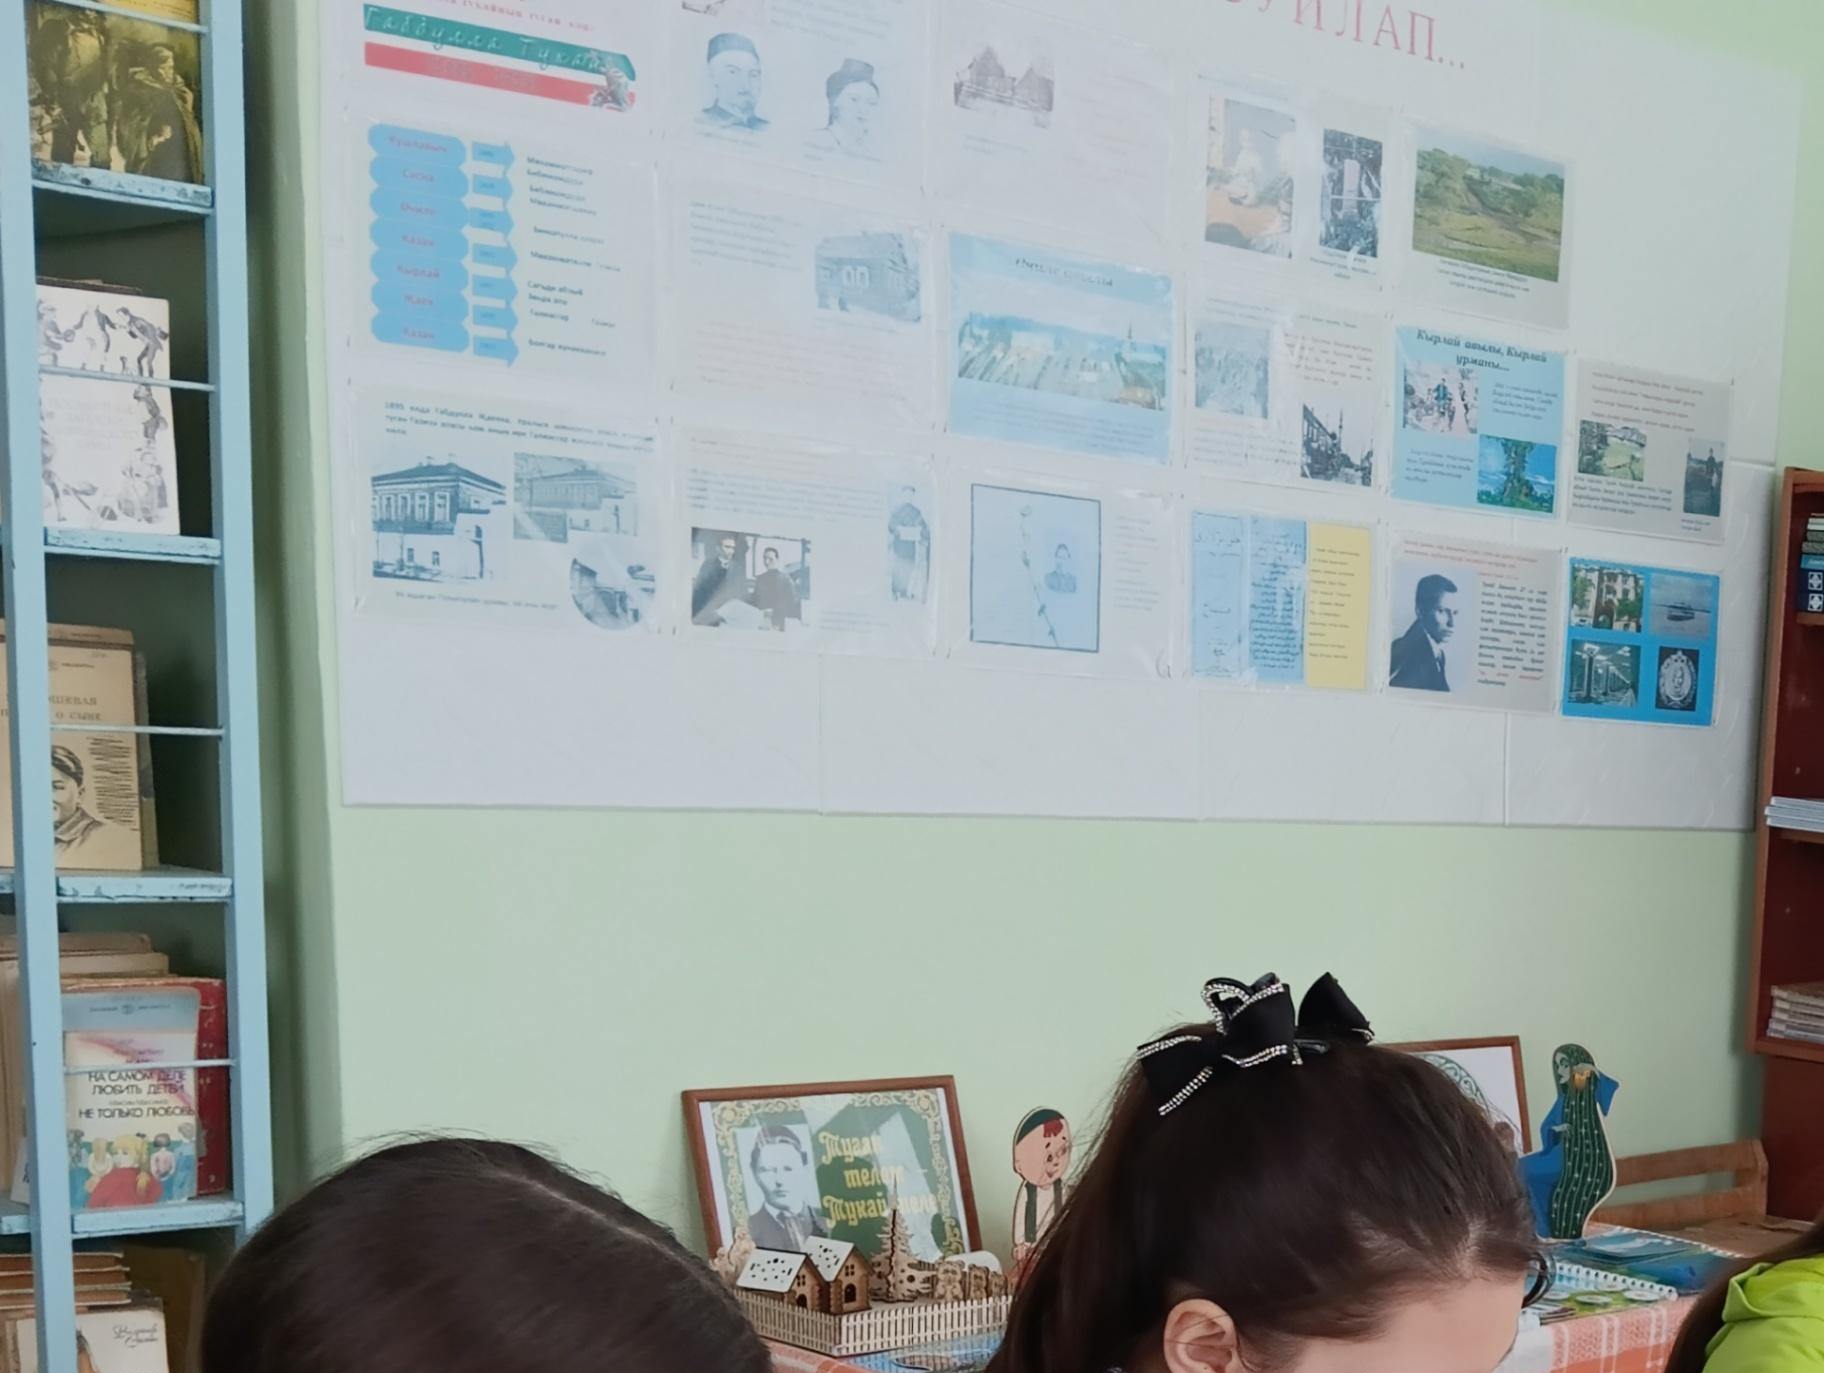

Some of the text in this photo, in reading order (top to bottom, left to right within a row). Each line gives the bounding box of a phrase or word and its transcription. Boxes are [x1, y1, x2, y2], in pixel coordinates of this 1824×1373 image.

[1416, 329, 1460, 347] Кырлай
[1506, 346, 1547, 363] Кырлай
[48, 695, 97, 706] ШЕВАЯ
[88, 1071, 106, 1082] НА
[108, 1071, 153, 1082] САМОМ
[91, 1084, 142, 1095] ЛЮБИТЬ
[78, 1106, 196, 1119] НЕ ТОЛЬКО ЛЮБОВЬ
[818, 1131, 881, 1165] Туган
[822, 1192, 888, 1229] Тукай
